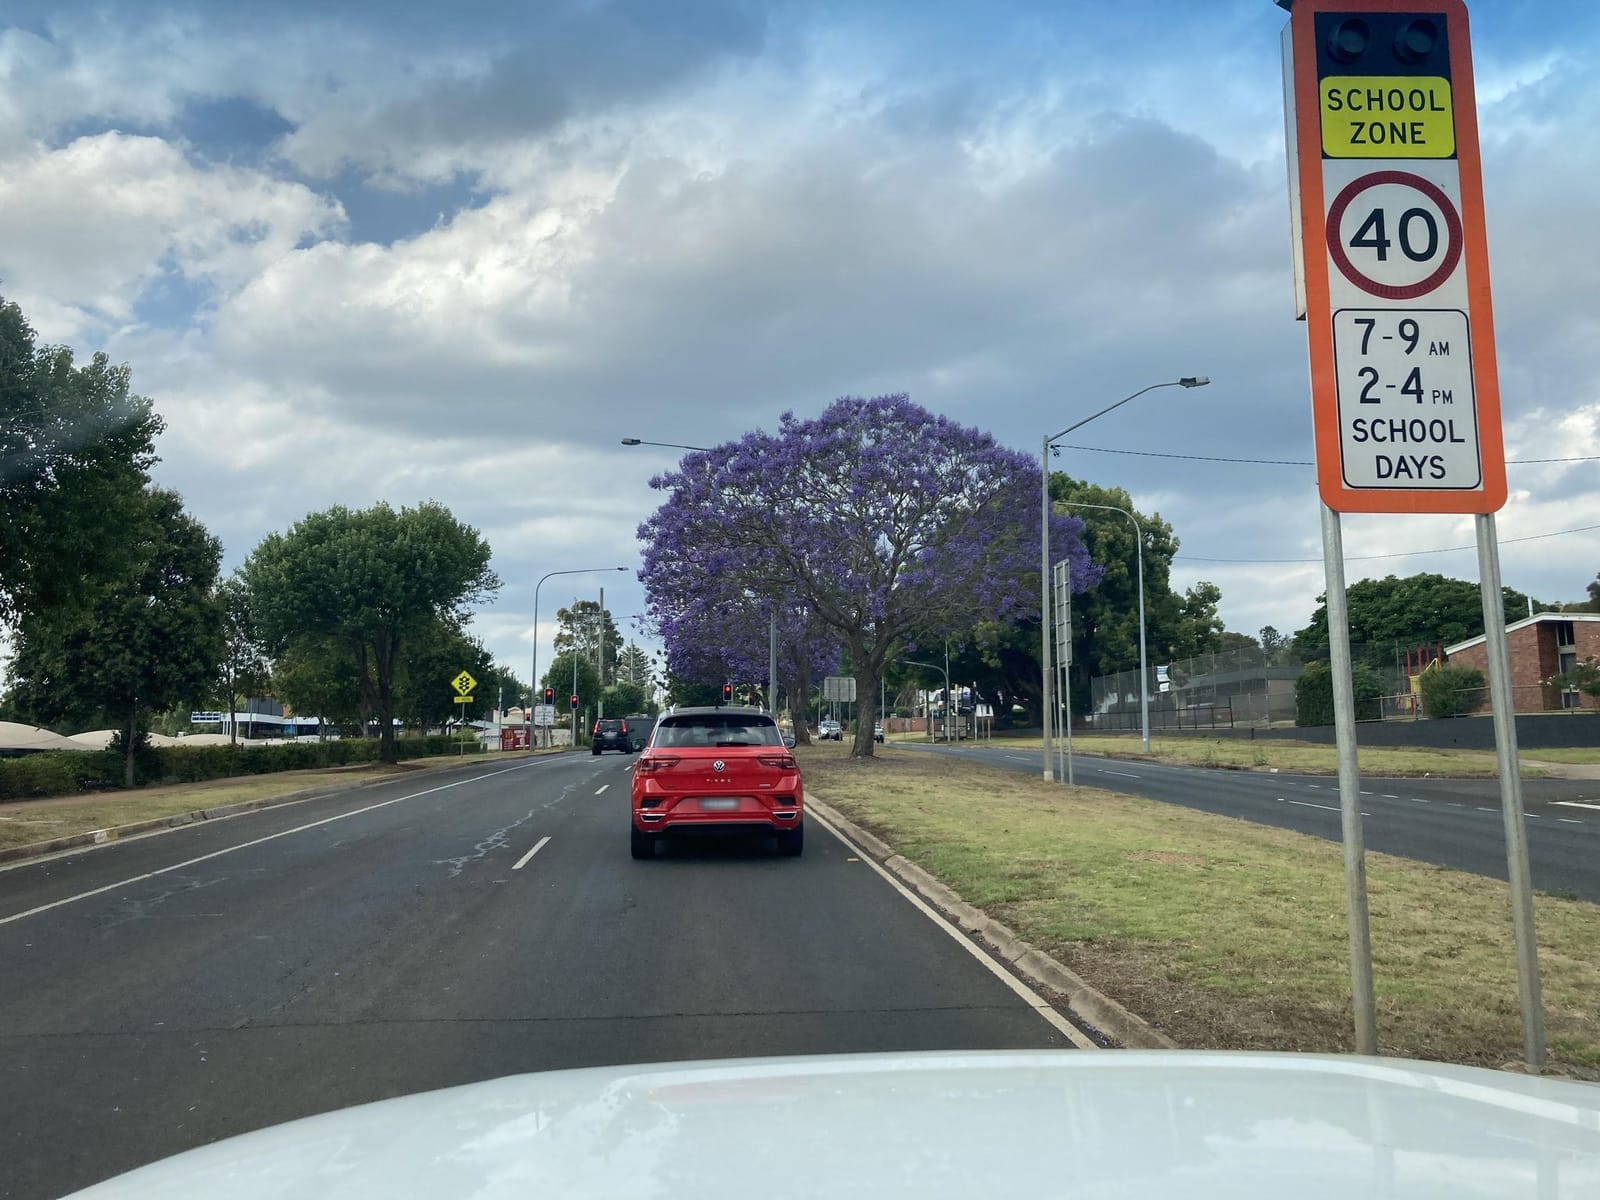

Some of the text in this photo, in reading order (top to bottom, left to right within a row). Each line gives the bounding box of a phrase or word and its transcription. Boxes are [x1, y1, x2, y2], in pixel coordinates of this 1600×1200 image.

[1327, 88, 1446, 112] SCHOOL
[1350, 121, 1426, 145] ZONE
[1349, 207, 1439, 262] 40
[1354, 318, 1450, 356] 7-9 AM
[1357, 366, 1453, 405] 2-4 PM
[1352, 418, 1466, 443] SCHOOL
[1375, 454, 1446, 480] DAYS
